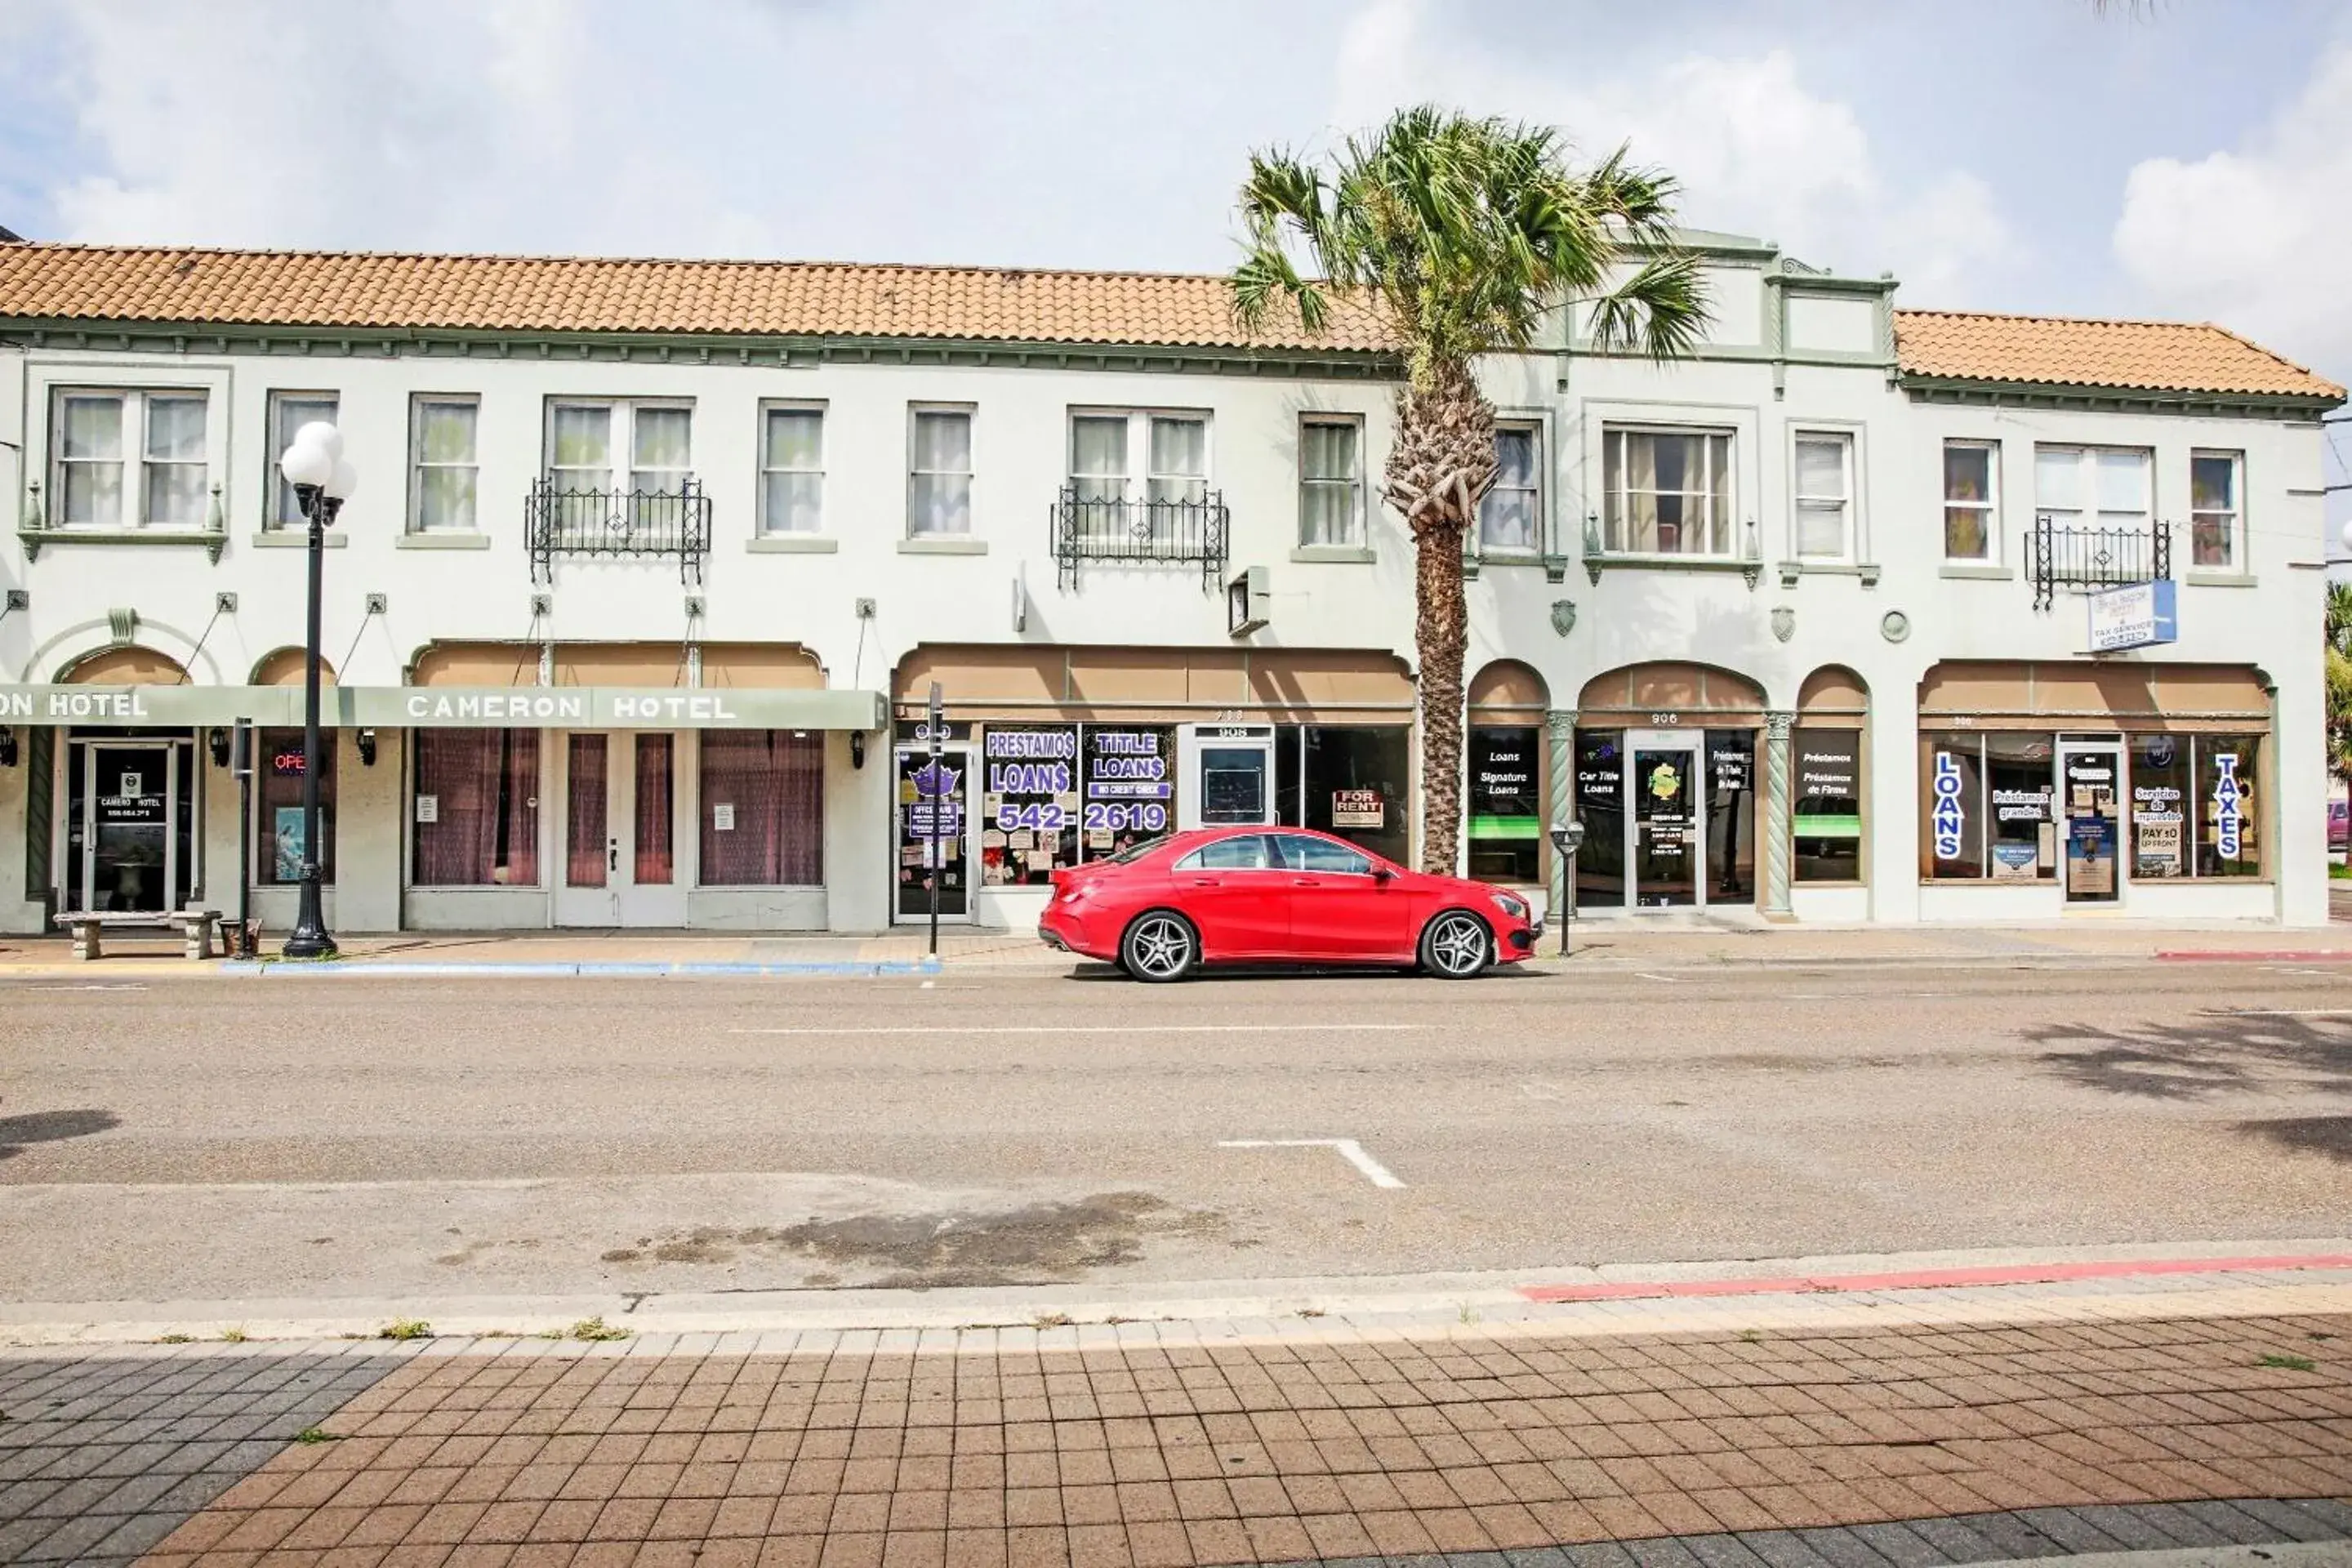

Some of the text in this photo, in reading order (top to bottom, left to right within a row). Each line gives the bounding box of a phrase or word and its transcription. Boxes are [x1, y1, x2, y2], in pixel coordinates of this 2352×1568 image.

[50, 693, 148, 716] HOTEL
[408, 697, 737, 719] CAMERON HOTEL
[1652, 714, 1677, 724] 906
[1096, 733, 1158, 754] TITLE
[274, 755, 306, 769] OPE
[1490, 752, 1520, 762] Loans
[1481, 772, 1528, 784] Signature
[1579, 771, 1619, 781] Car Title
[1489, 785, 1519, 795] Loans
[1584, 783, 1615, 793] Loans
[2135, 786, 2180, 800] Servicios
[1342, 792, 1373, 802] FOR
[1337, 802, 1379, 812] RENT
[1934, 751, 1963, 859] LOANS
[2150, 799, 2164, 811] de
[2212, 754, 2243, 858] TAXES
[1084, 803, 1166, 831] 2619
[2142, 828, 2163, 839] PAY
